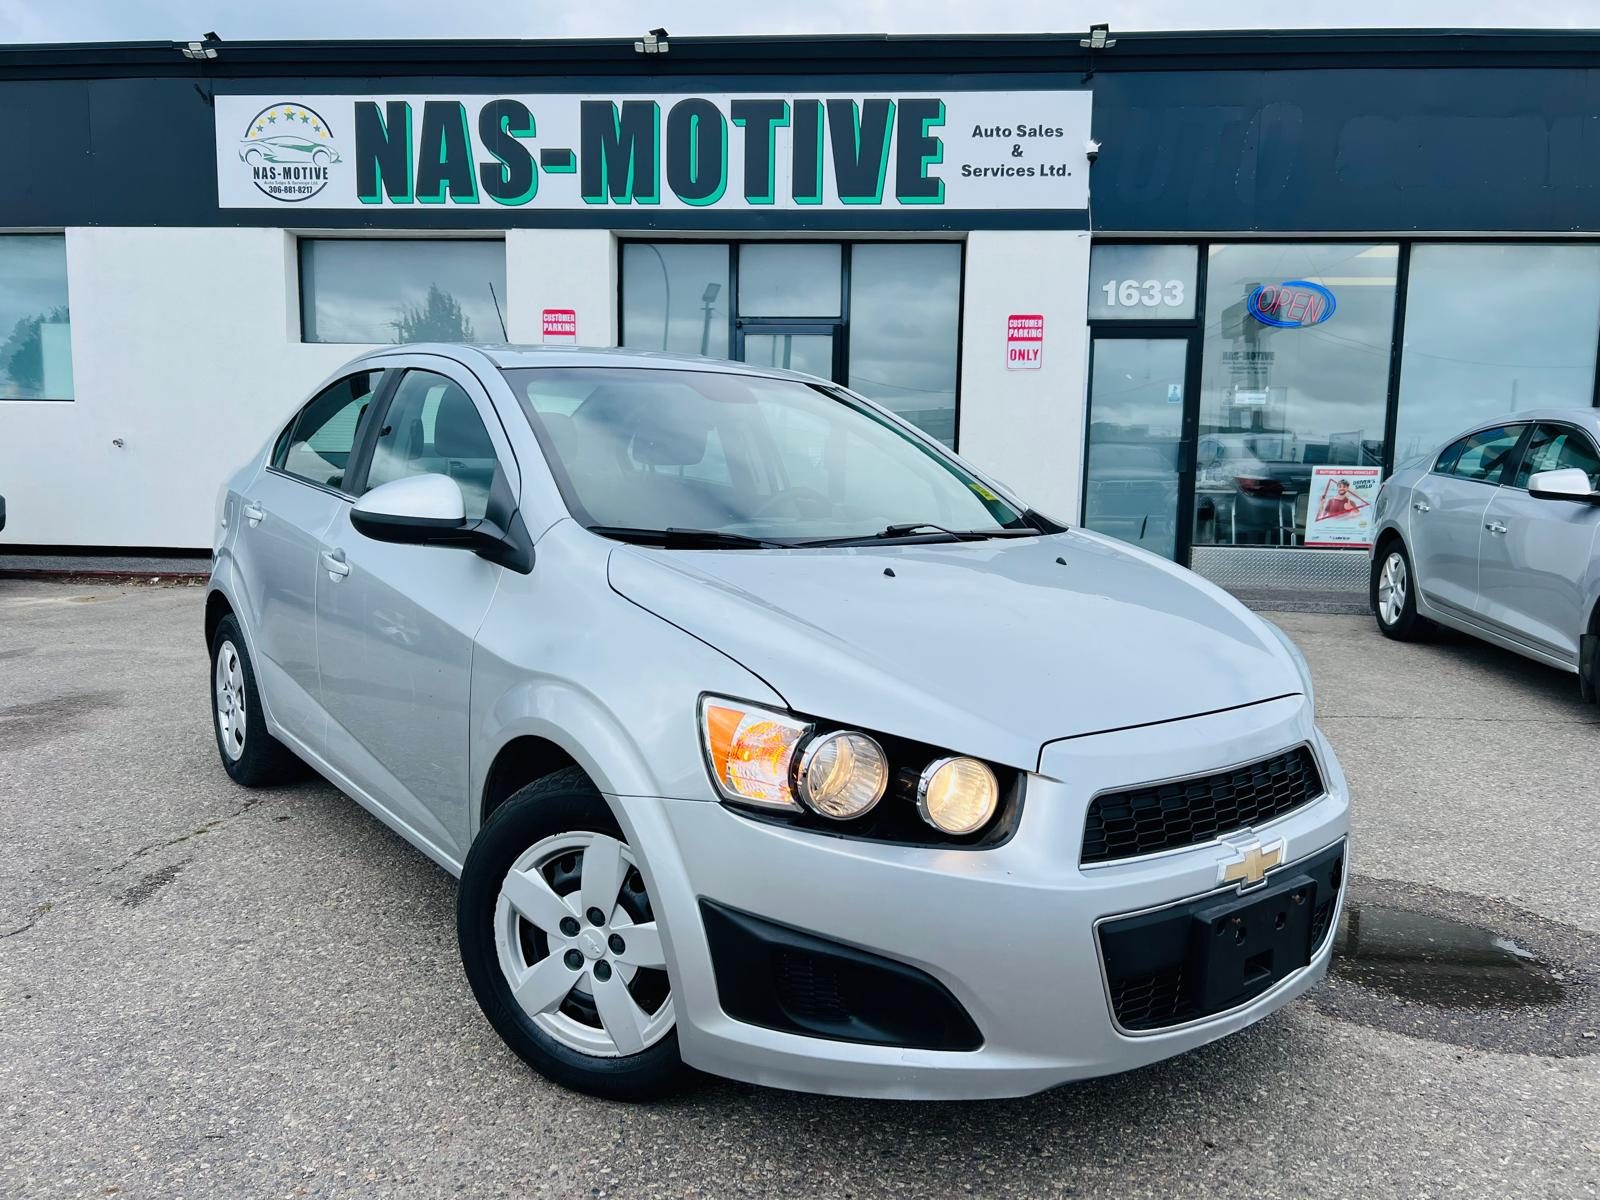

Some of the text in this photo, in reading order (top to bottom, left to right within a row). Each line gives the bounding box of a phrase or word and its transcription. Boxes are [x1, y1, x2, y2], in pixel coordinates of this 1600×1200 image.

[972, 124, 1064, 138] Auto Sales
[354, 99, 946, 206] NAS-MOTIVE
[1011, 143, 1024, 158] &
[253, 166, 328, 180] NAS-MOTIVE
[961, 163, 1072, 177] Services Ltd.
[268, 185, 313, 194] 306-881-8217
[1102, 279, 1185, 307] 1633
[1257, 284, 1324, 324] OPEN
[544, 314, 575, 322] CUSTOMER
[1009, 319, 1042, 328] CUSTOMER
[544, 322, 575, 331] PARKING
[1009, 328, 1042, 338] PARKING
[1010, 348, 1039, 361] ONLY
